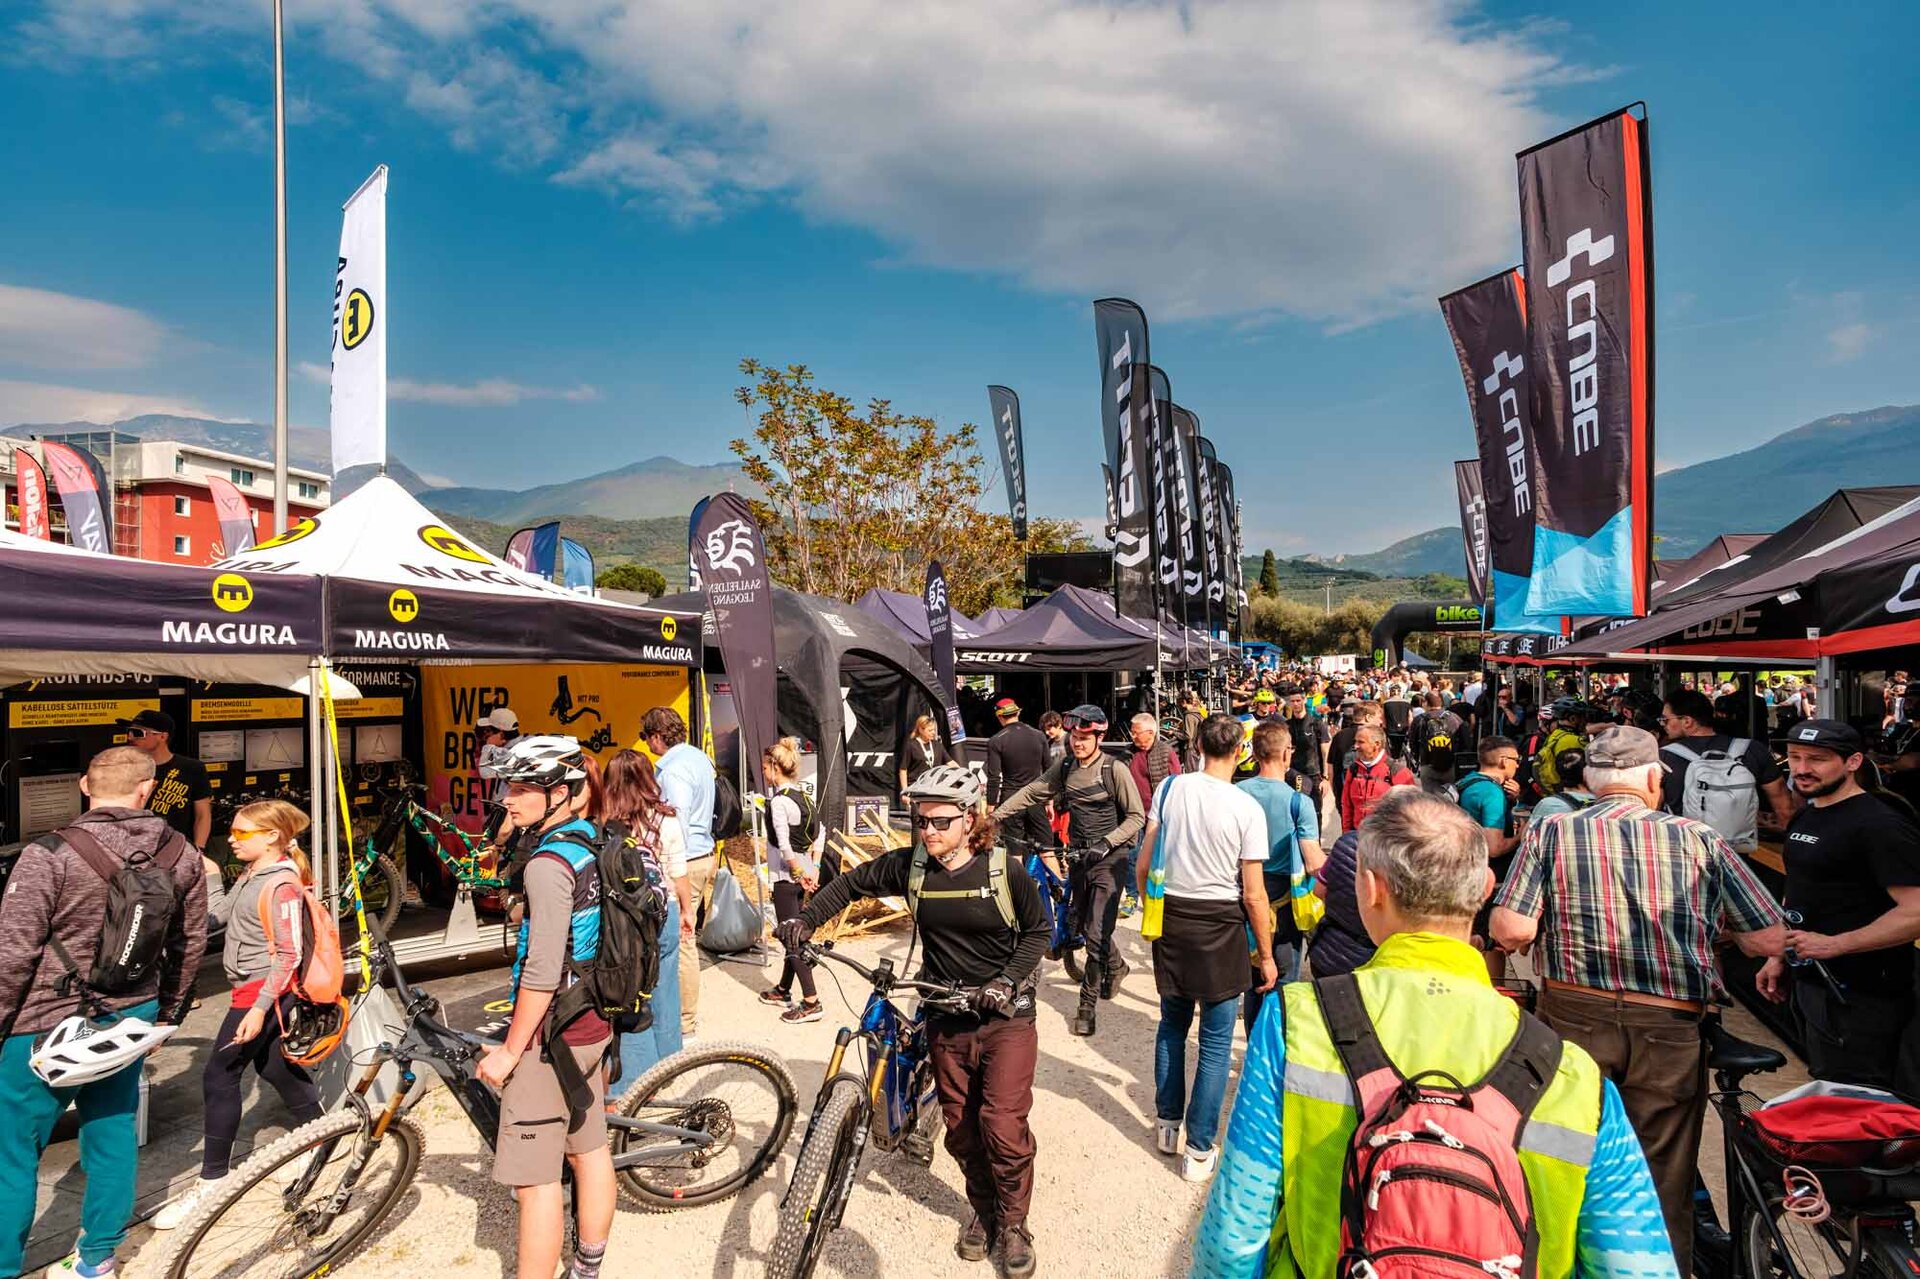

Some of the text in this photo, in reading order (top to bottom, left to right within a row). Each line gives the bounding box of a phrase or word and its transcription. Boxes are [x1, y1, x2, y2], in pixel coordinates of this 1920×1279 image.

[1436, 606, 1480, 621] bike
[162, 621, 297, 645] MAGURA
[354, 629, 451, 650] MAGURA
[642, 645, 693, 661] MAGURA
[959, 652, 1033, 662] SCOTT
[162, 778, 189, 796] WHO
[150, 798, 171, 815] YOU
[154, 788, 189, 809] STOPS
[1789, 832, 1820, 844] CUBE
[119, 904, 144, 966] ROCKRIDER
